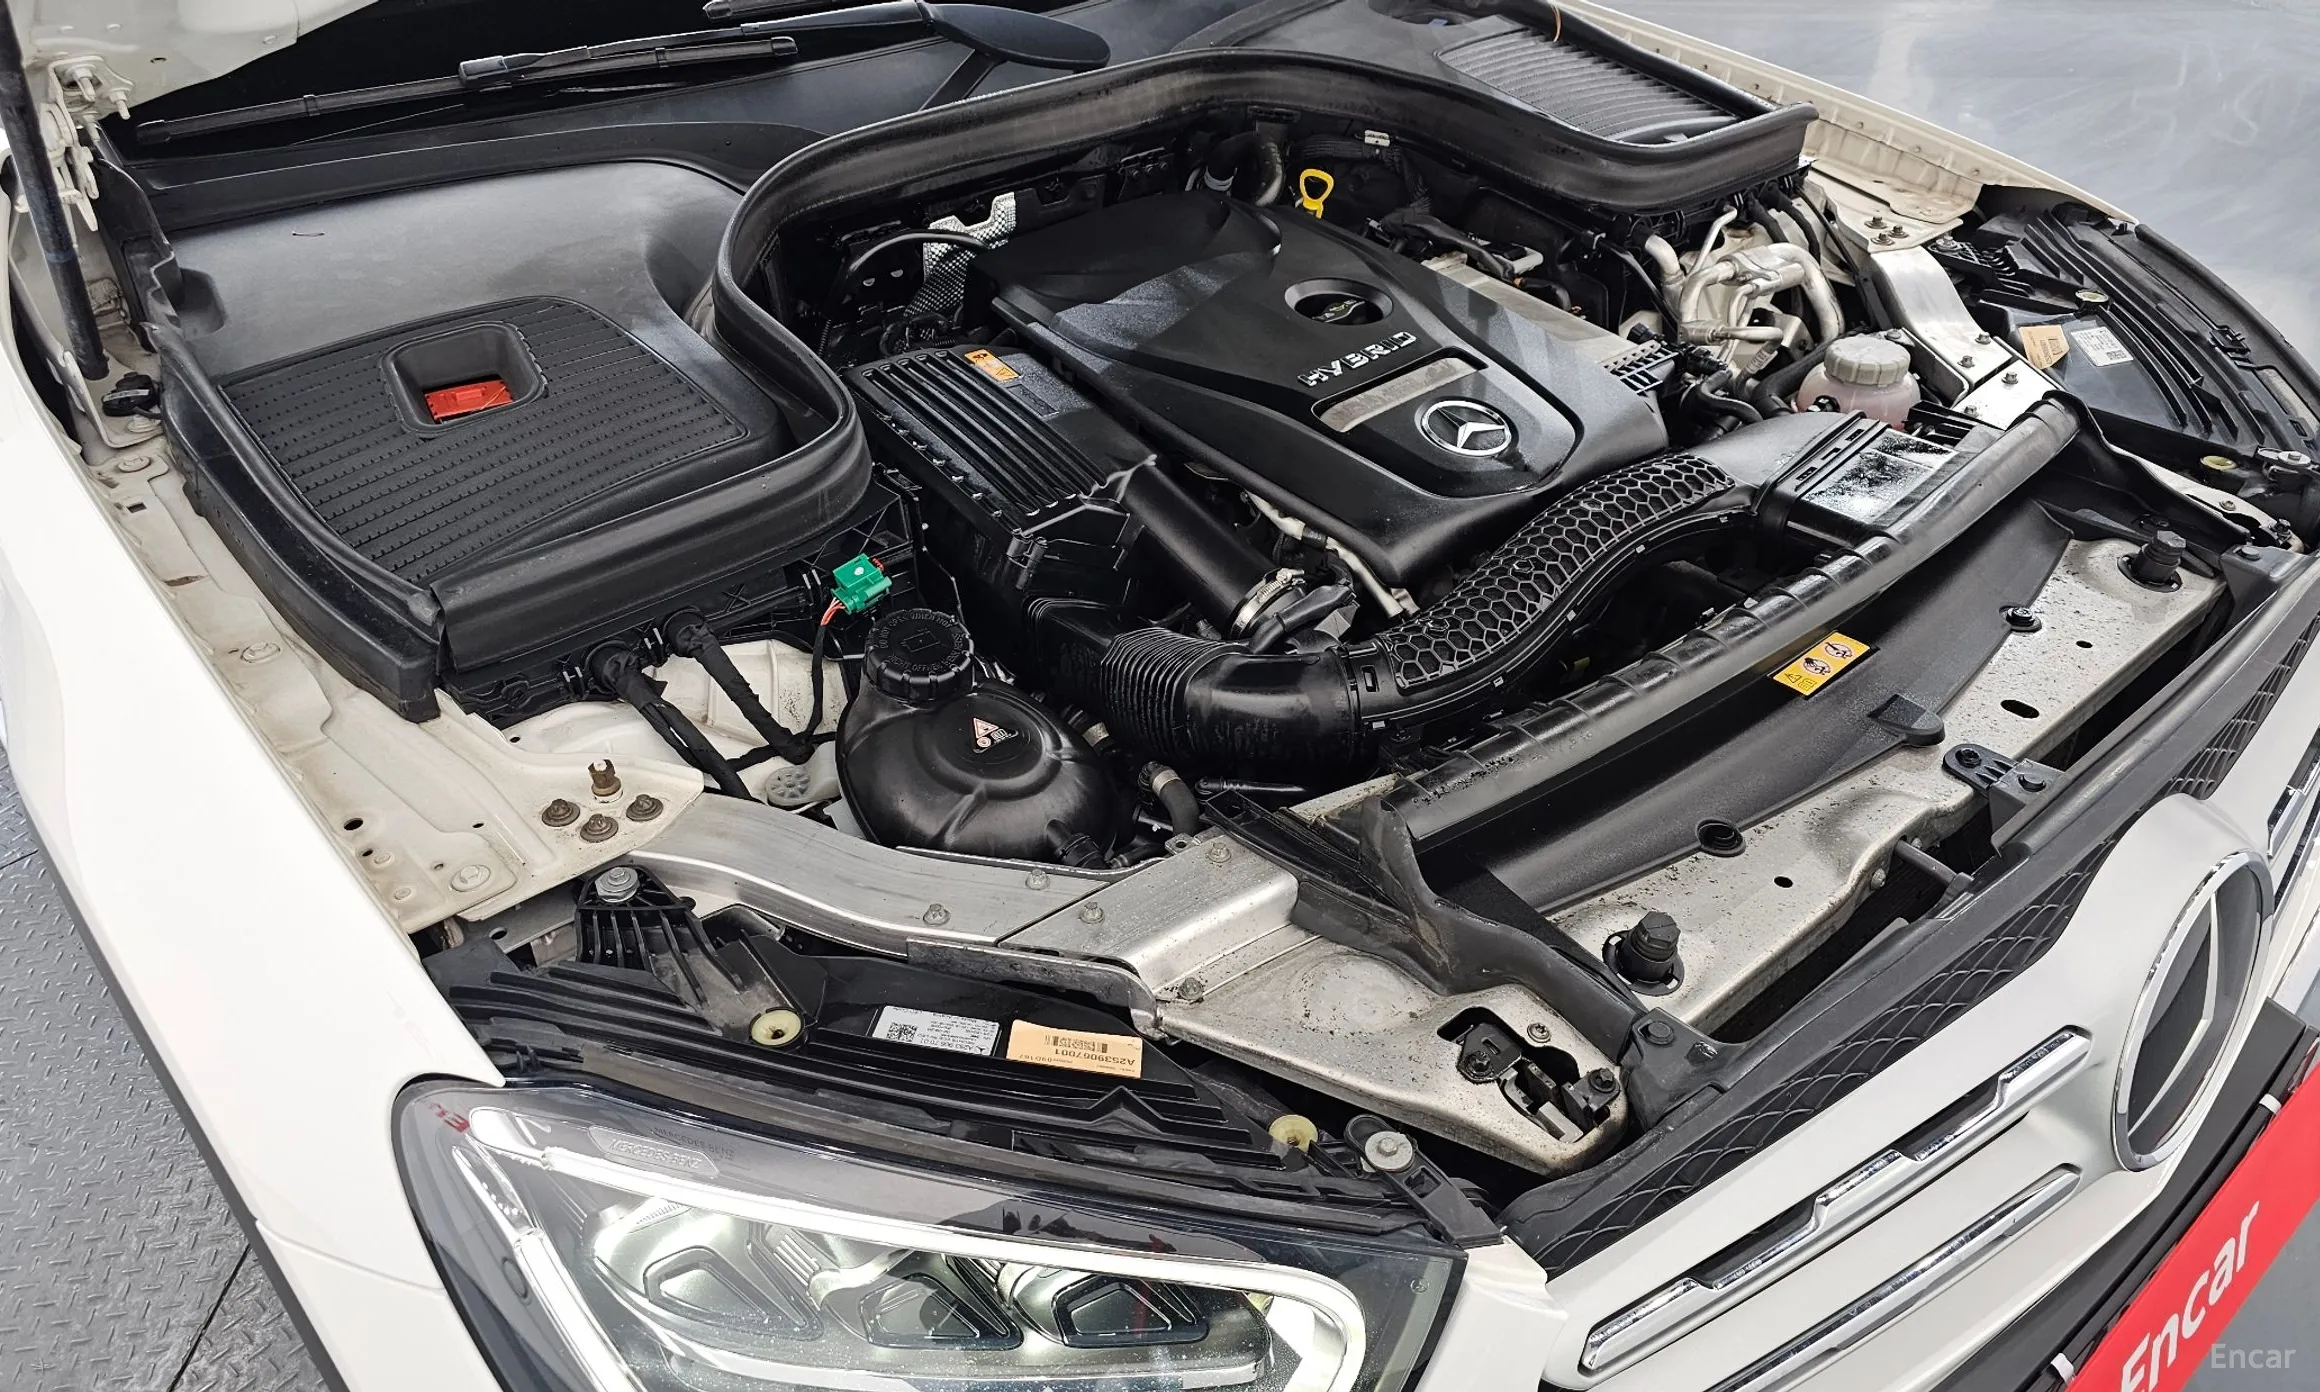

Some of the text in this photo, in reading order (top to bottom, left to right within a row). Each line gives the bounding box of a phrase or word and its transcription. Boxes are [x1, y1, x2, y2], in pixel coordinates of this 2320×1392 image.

[1298, 332, 1417, 386] HYBRID
[1055, 1048, 1136, 1066] A2539067001
[2120, 1200, 2260, 1392] Encar
